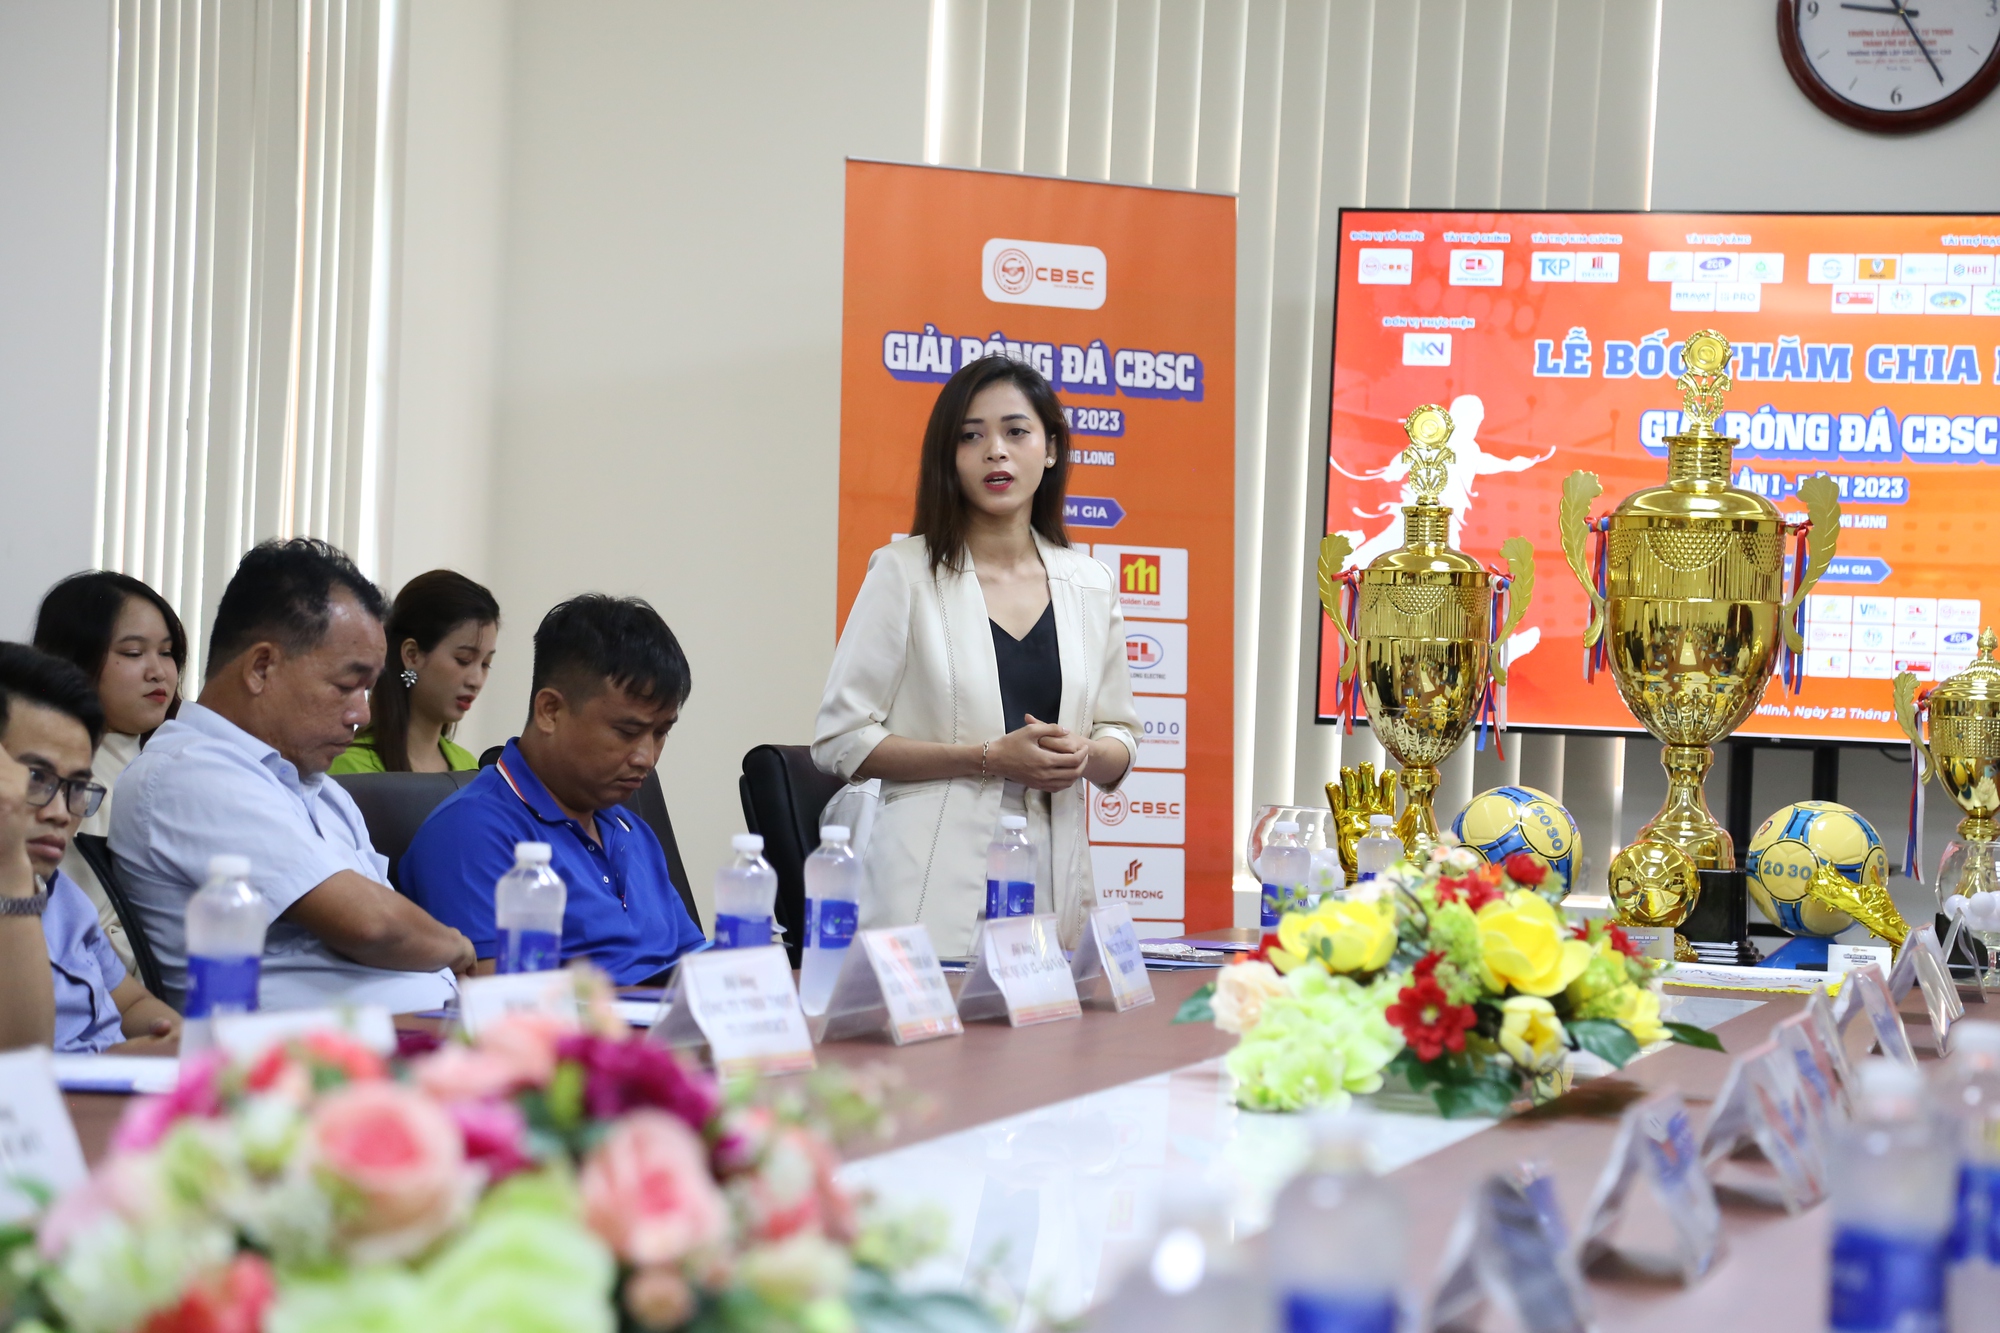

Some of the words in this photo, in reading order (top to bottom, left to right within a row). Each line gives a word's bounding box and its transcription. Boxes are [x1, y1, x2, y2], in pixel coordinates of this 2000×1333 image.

[1807, 1, 1819, 20] 9
[1890, 85, 1902, 105] 6
[1035, 267, 1095, 285] CBSC
[884, 324, 955, 375] GIẢI
[1060, 341, 1108, 386] ĐÁ
[1114, 349, 1197, 392] CBSC
[1534, 328, 1591, 376] LỄ
[1866, 344, 1981, 385] CHIA
[1077, 408, 1121, 432] 2023
[1724, 403, 1831, 452] BÓNG
[1838, 407, 1893, 453] ĐÁ
[1901, 414, 1998, 455] CBSC
[1083, 450, 1115, 466] LONG
[1853, 476, 1904, 499] 2023
[1082, 505, 1108, 519] GIA
[1854, 514, 1888, 529] LONG
[1851, 564, 1873, 576] GIA
[1119, 597, 1141, 605] Golden
[1143, 598, 1161, 607] Lotus
[1755, 703, 1791, 718] Minh,
[1793, 704, 1828, 722] Ngày
[1830, 707, 1847, 719] 22
[1849, 707, 1891, 723] Tháng
[1130, 802, 1180, 815] CBSC
[1103, 889, 1113, 898] LY
[1116, 889, 1128, 899] TU
[1130, 890, 1164, 900] TRONG
